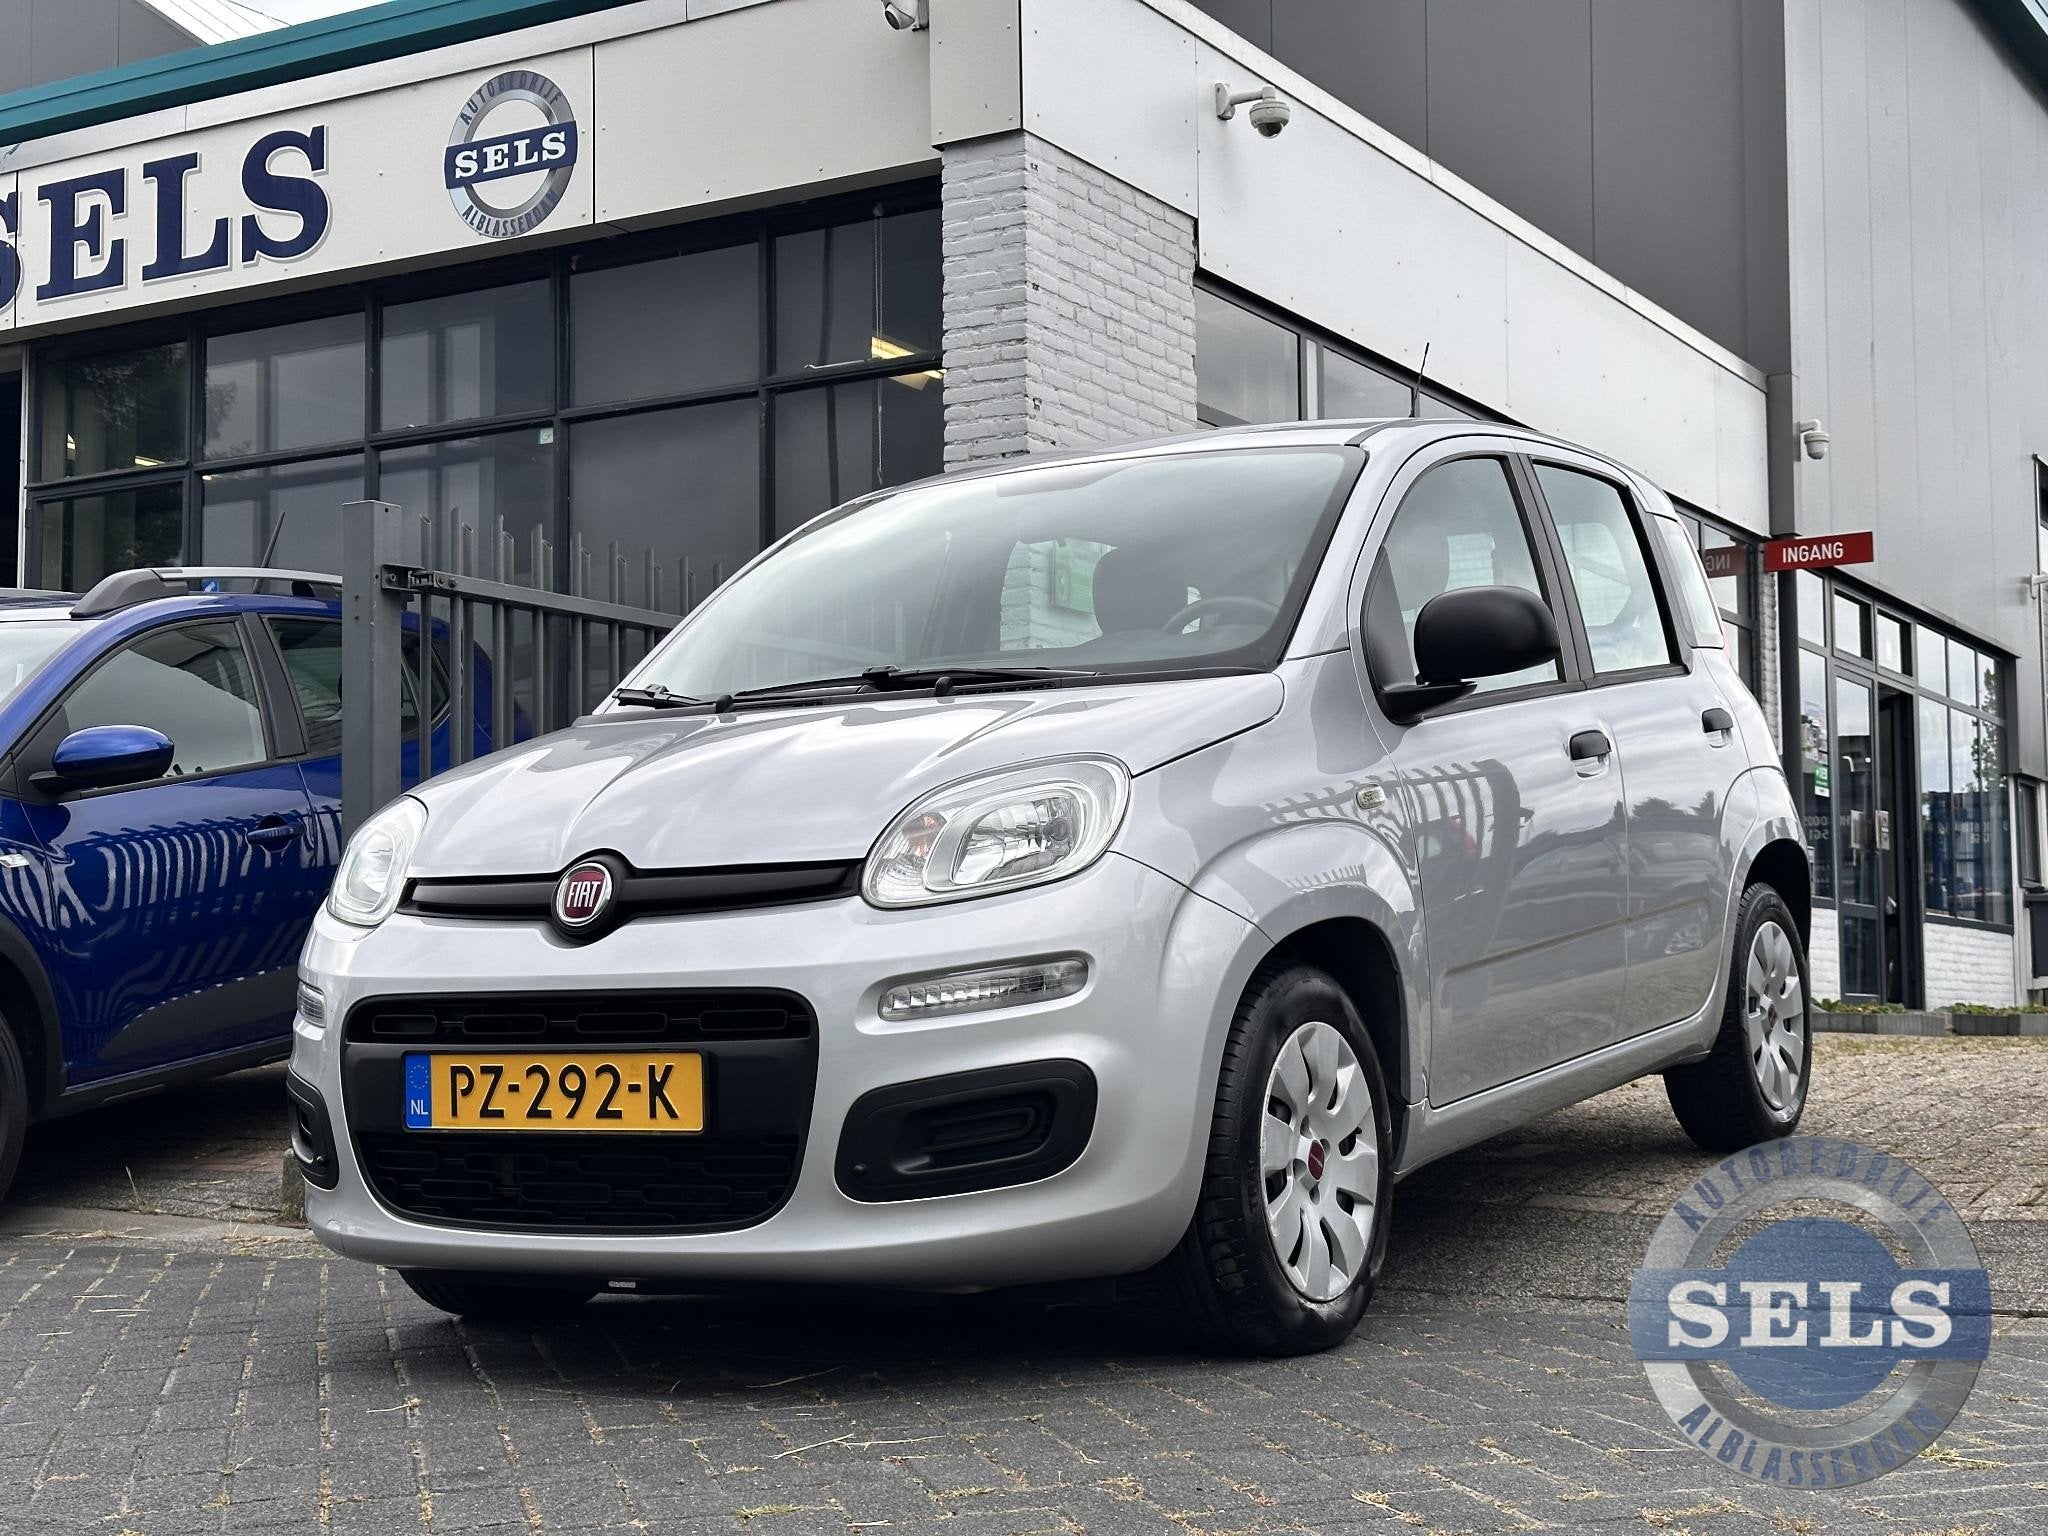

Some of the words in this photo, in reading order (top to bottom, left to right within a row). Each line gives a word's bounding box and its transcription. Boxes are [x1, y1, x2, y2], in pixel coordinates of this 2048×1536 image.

[460, 72, 563, 126] AUTOBEDRIJF
[455, 131, 566, 179] SELS
[0, 125, 332, 311] ELS
[462, 189, 561, 238] ALBLASSERDAM
[1782, 541, 1844, 564] INGANG
[566, 880, 602, 908] FIAT
[410, 1098, 429, 1116] NL
[449, 1063, 680, 1120] PZ-292-K
